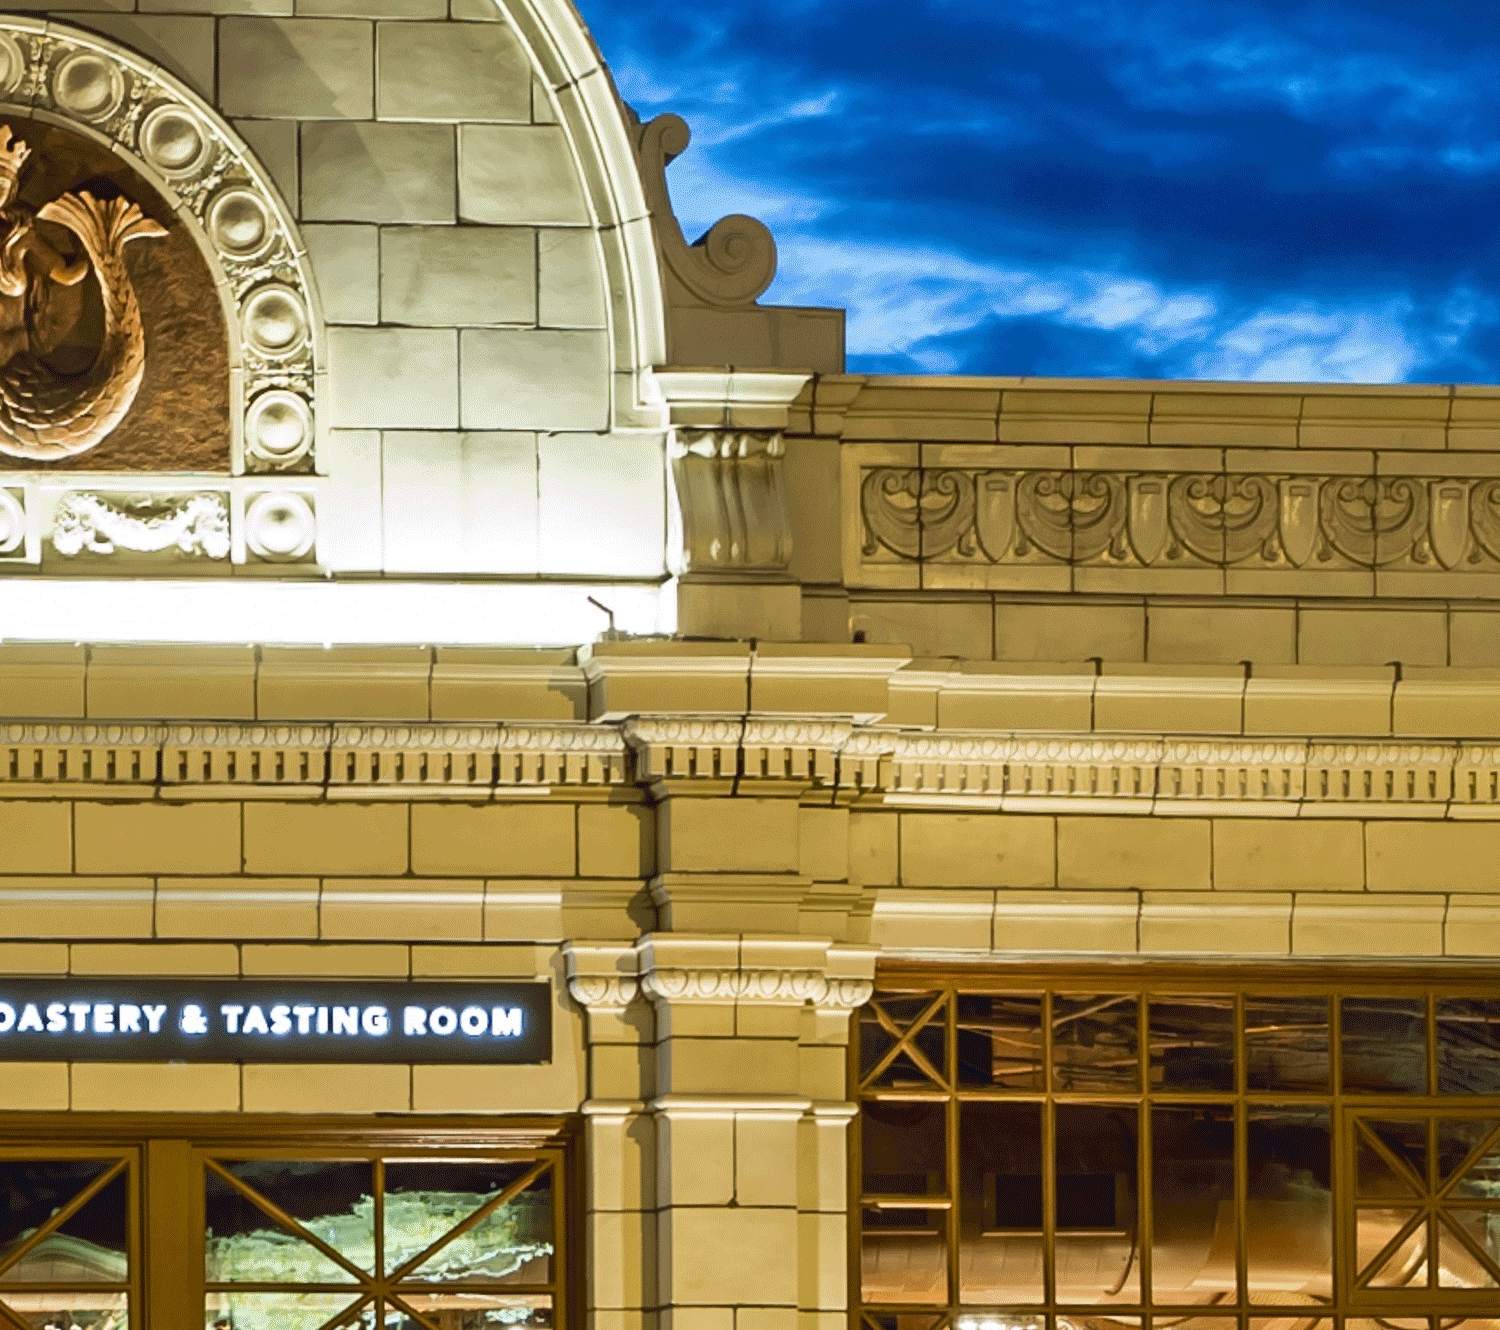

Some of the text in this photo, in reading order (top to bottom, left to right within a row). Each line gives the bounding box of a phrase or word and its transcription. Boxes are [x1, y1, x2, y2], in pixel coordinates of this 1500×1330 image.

[182, 1005, 207, 1034] &
[222, 1006, 389, 1036] TASTING
[404, 1007, 523, 1037] ROOM
